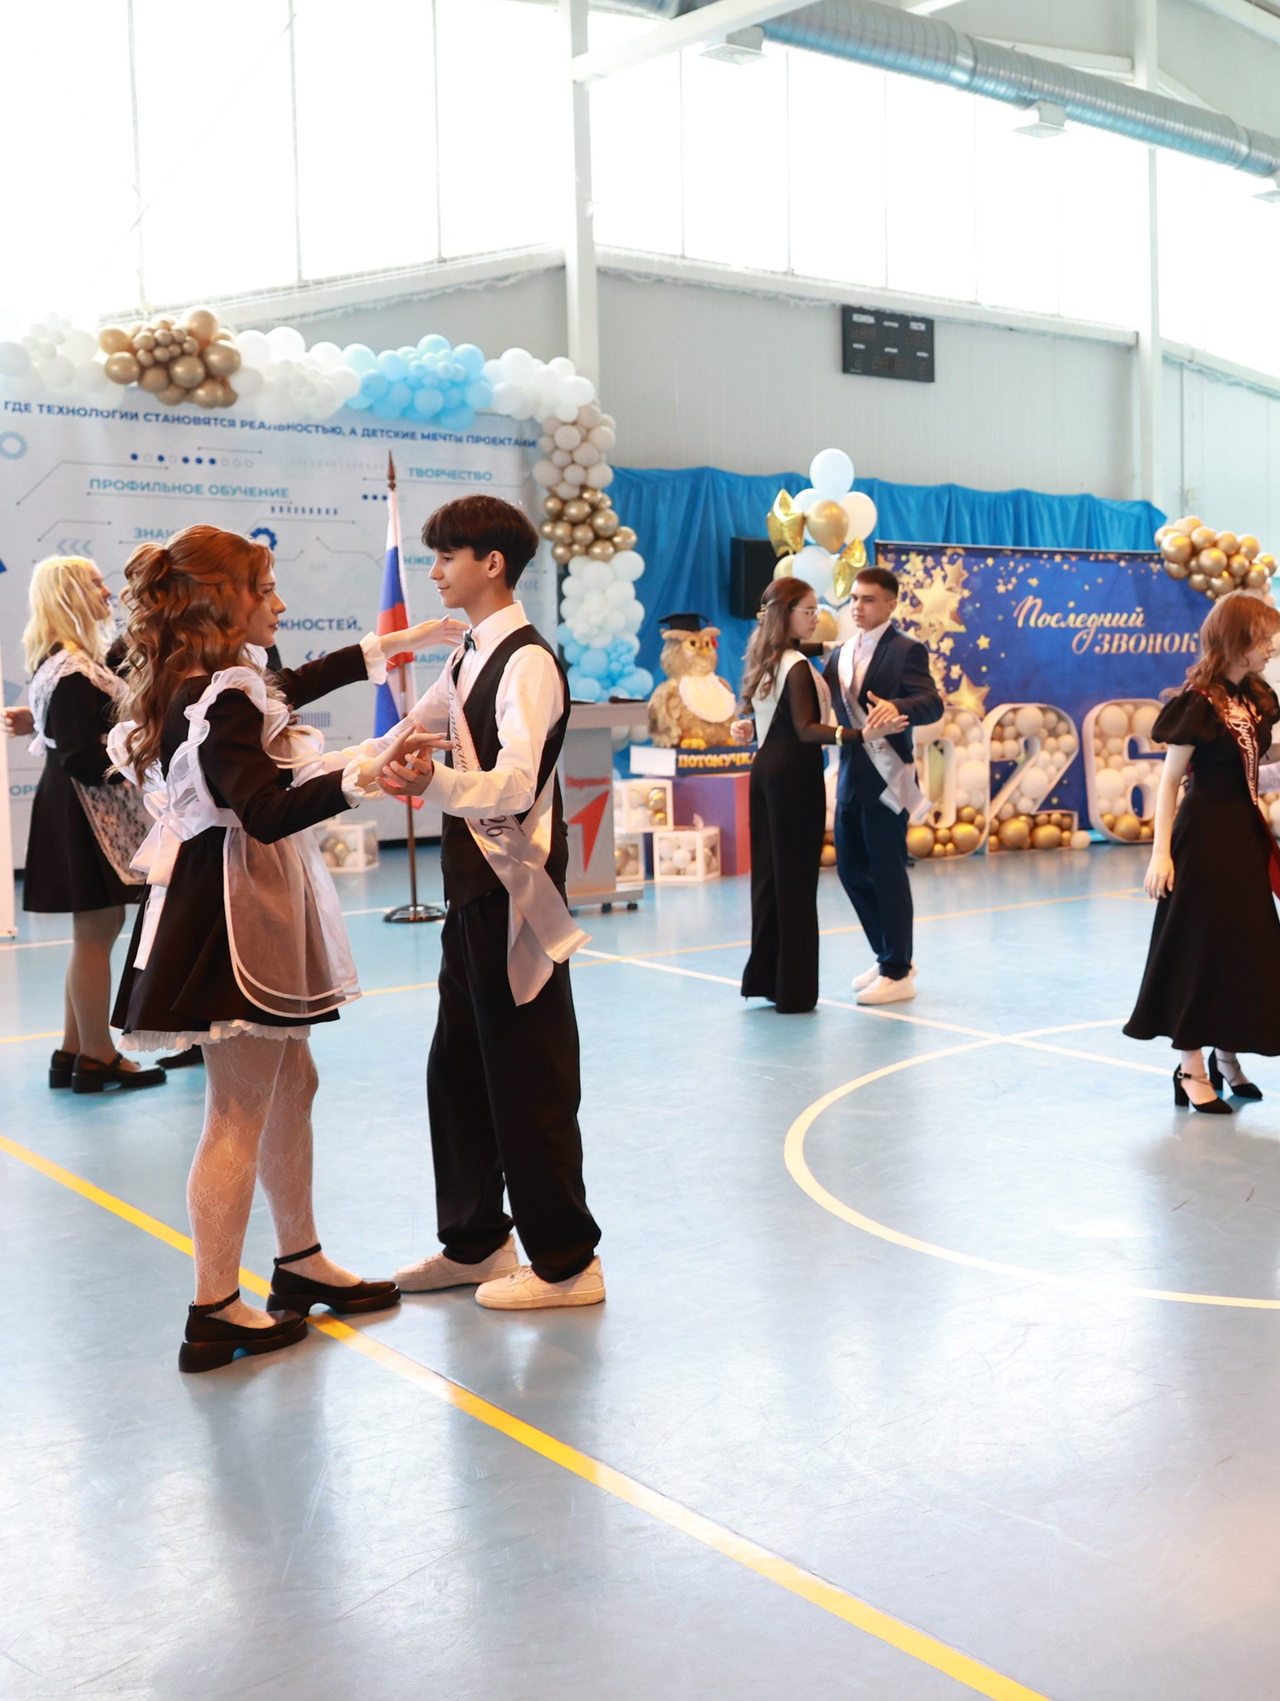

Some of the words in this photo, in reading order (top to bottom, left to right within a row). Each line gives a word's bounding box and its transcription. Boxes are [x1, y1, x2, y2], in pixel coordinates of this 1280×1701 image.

[4, 400, 33, 414] ГДЕ
[38, 404, 140, 422] ТЕХНОЛОГИИ
[143, 412, 237, 428] СТАНОВЯТСЯ
[348, 427, 358, 436] А
[361, 427, 417, 440] ДЕТСКИЕ
[421, 432, 463, 443] МЕЧТЫ
[89, 478, 204, 495] ПРОФИЛЬНОЕ
[208, 484, 290, 499] ОБУЧЕНИЕ
[407, 467, 493, 481] ТВОРЧЕСТВО
[1012, 595, 1145, 655] Последний
